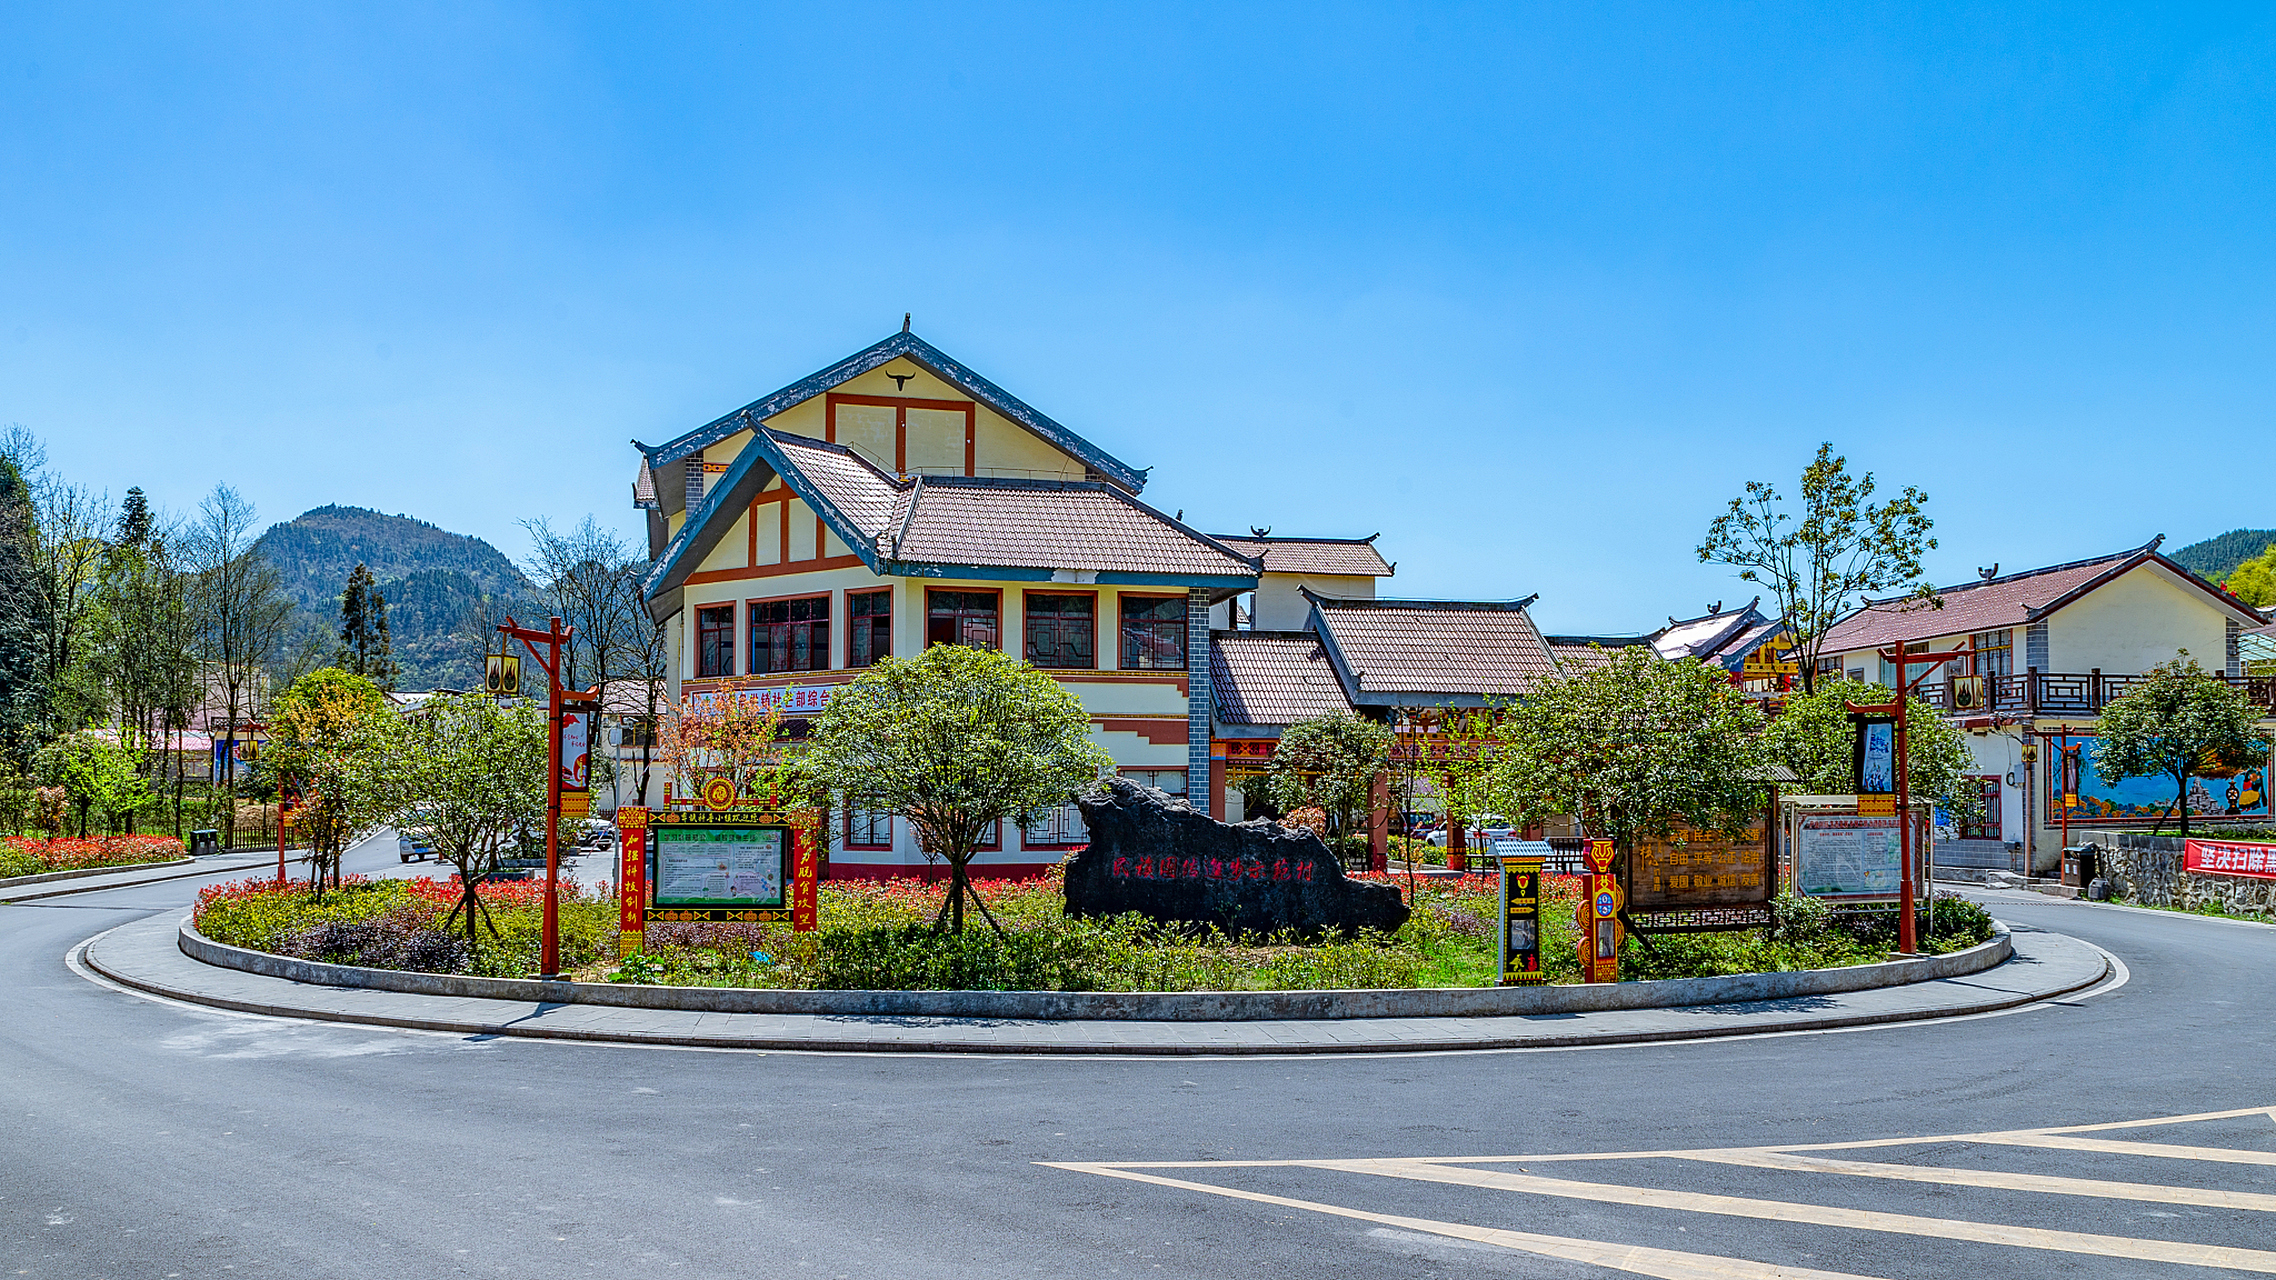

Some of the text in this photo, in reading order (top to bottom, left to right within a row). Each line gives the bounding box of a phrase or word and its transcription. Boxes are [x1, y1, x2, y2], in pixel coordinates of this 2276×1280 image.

[1693, 829, 1713, 842] 民主
[1669, 850, 1760, 866] 自由 平等 公正 法治
[624, 834, 639, 925] 加强科技创新
[1669, 873, 1760, 889] 爱国 敬业 诚信 友善
